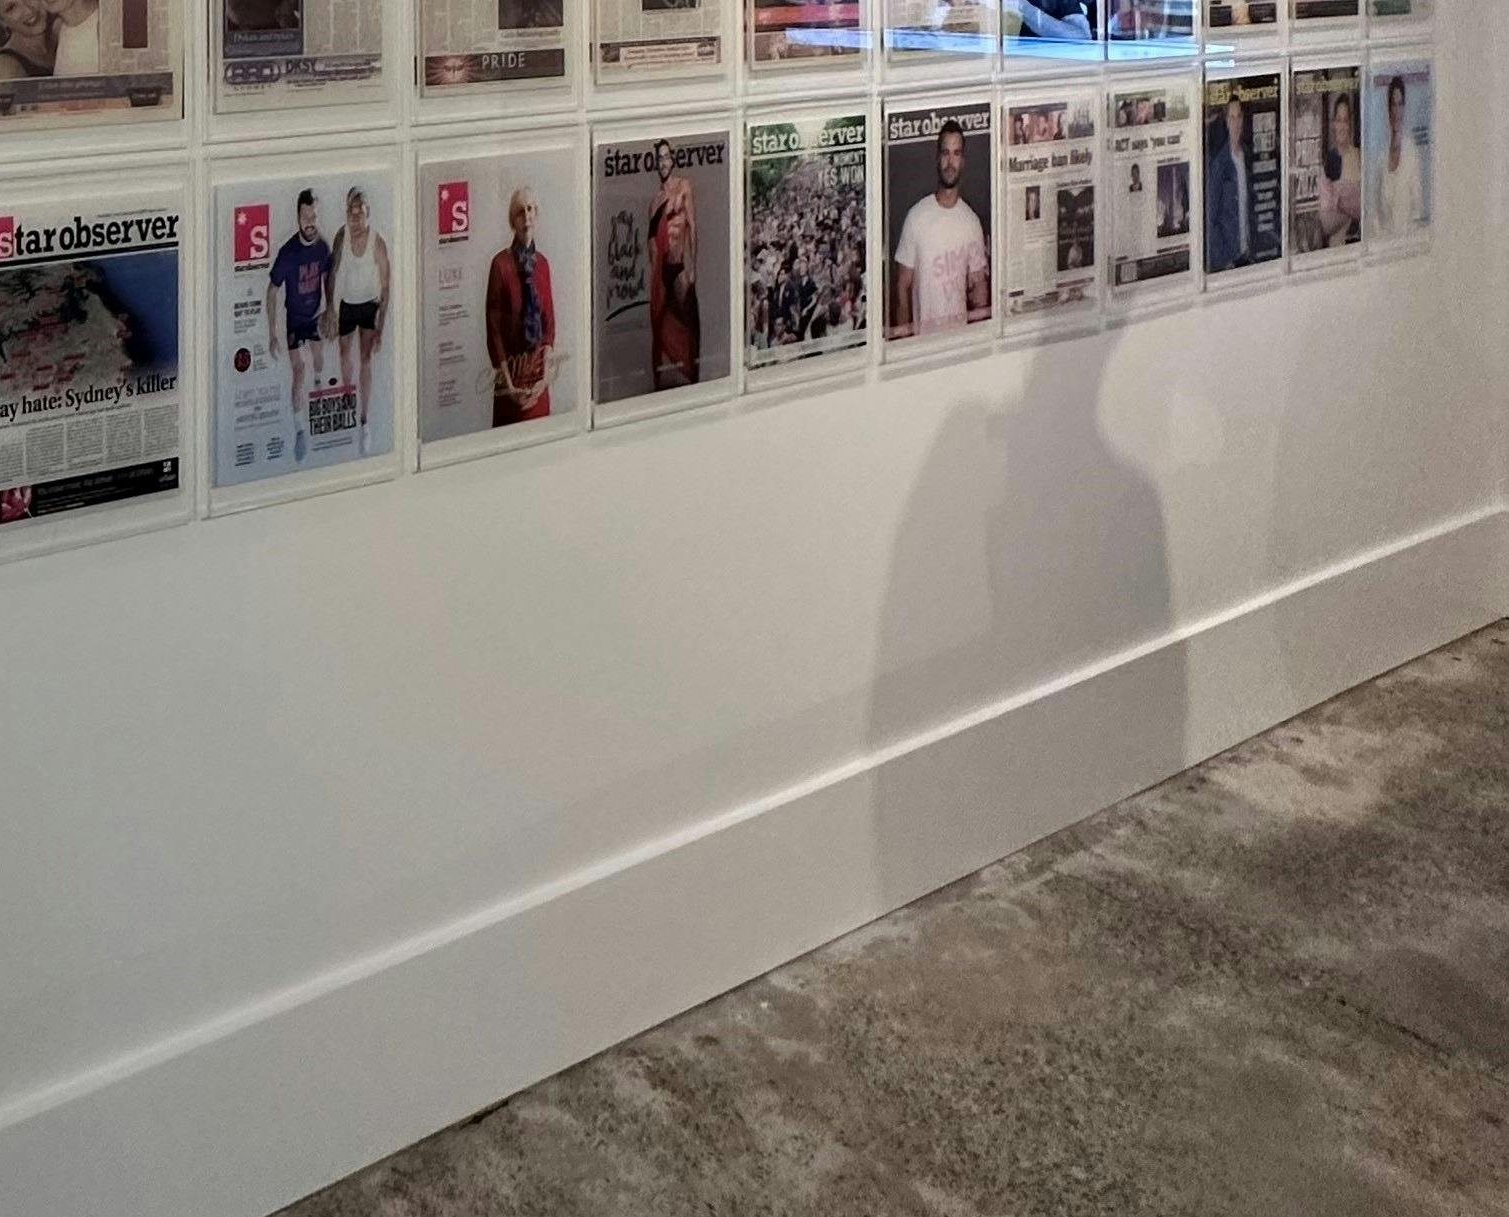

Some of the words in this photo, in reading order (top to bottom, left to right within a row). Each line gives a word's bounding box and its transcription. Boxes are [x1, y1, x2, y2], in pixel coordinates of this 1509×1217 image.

[482, 52, 526, 70] PRIDE
[890, 116, 921, 139] star
[752, 130, 788, 155] star
[604, 148, 641, 177] star
[840, 164, 865, 185] WON
[1009, 156, 1049, 173] Marriage
[452, 201, 467, 232] S
[59, 215, 179, 249] observer
[250, 225, 269, 259] S
[21, 392, 63, 416] hate:
[136, 374, 178, 396] killer
[309, 398, 320, 416] BIG
[322, 395, 341, 414] BOYS
[309, 415, 331, 436] THEIR
[332, 410, 357, 431] BALLS
